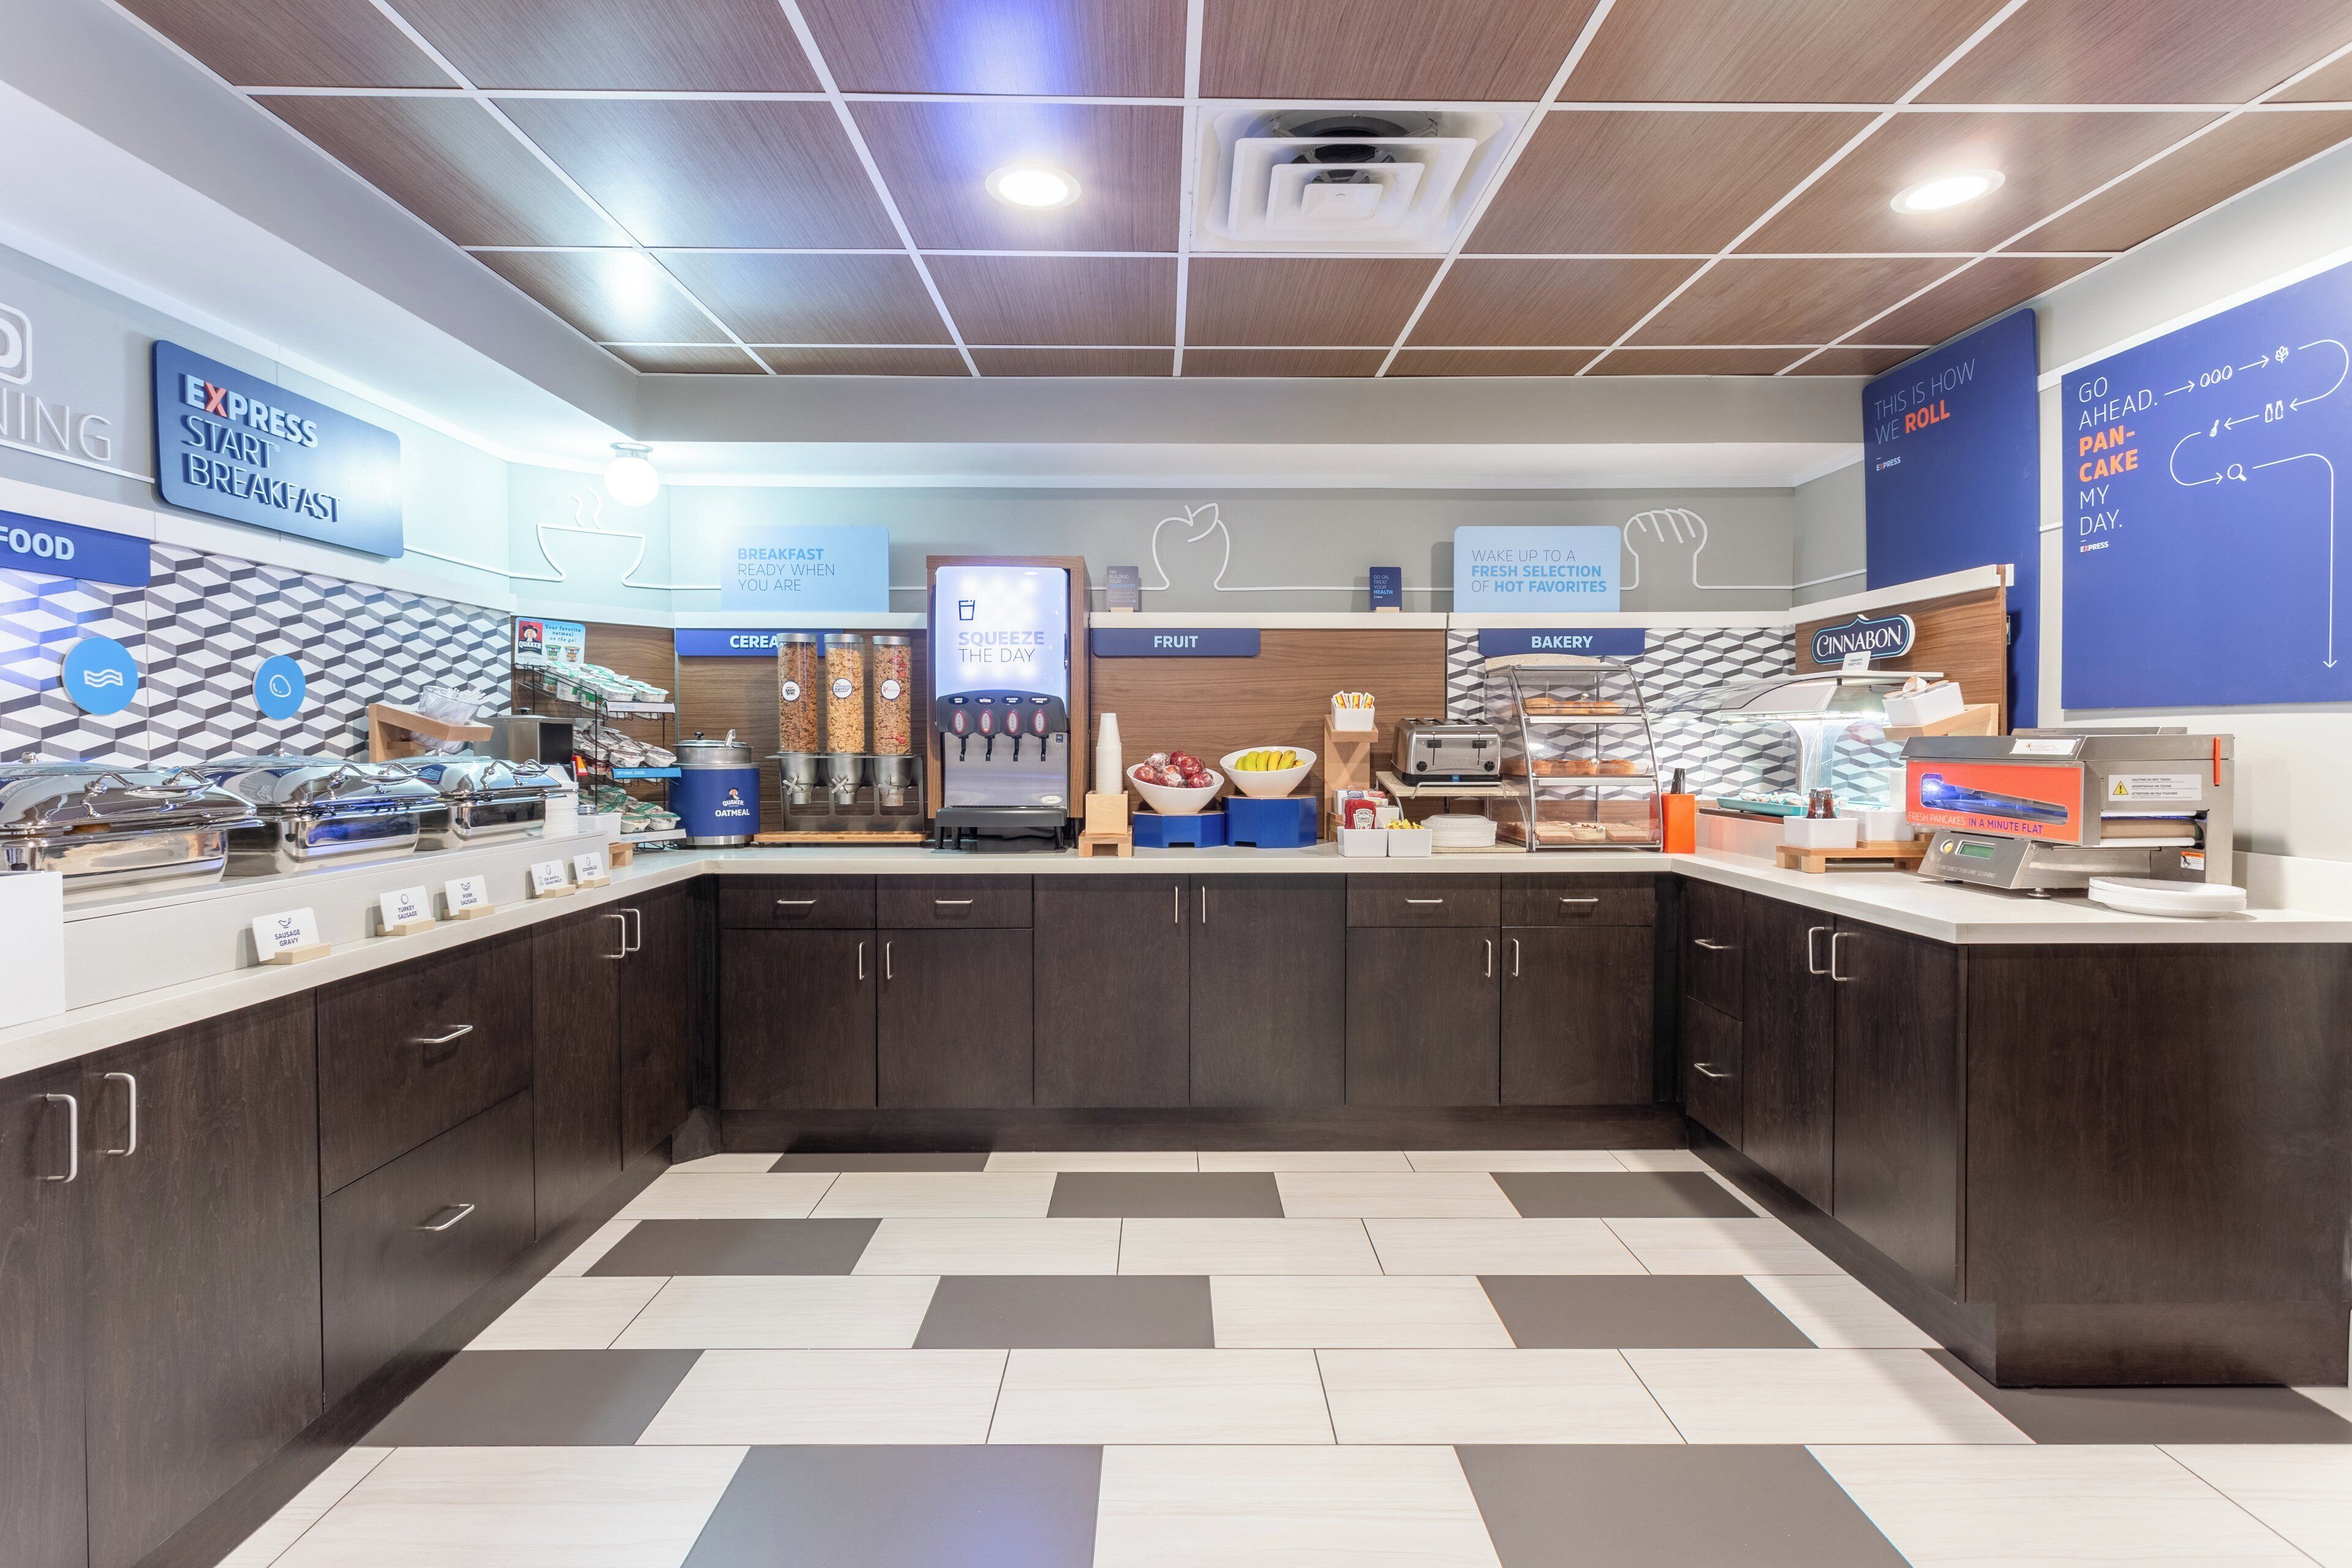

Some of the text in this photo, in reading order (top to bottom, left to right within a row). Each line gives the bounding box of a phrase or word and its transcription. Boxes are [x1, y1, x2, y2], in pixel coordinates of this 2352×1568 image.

[1874, 358, 1975, 420] THIS IS HOW
[2079, 377, 2108, 403] GO
[186, 374, 318, 448] EXPRESS
[2079, 389, 2158, 431] AHEAD.
[0, 387, 111, 461] ING
[1875, 399, 1950, 445] WE ROLL
[2079, 425, 2135, 457] PAN-
[1876, 456, 1901, 472] EXPRESS
[2079, 448, 2138, 483] CAKE
[188, 453, 343, 522] BREAKFAST
[2080, 484, 2109, 510] MY
[2080, 509, 2123, 536] DAY.
[737, 548, 824, 560] BREAKFAST
[2080, 541, 2109, 552] EXPRESS
[1471, 550, 1576, 562] WAKE UP TO A
[737, 564, 835, 576] READY WHEN
[1471, 565, 1601, 577] FRESH SELECTION
[737, 579, 801, 591] YOU ARE
[1471, 581, 1607, 592] OF HOT FAVORITES
[519, 641, 541, 649] QUAKER
[959, 631, 1044, 647] SQUEEZE
[1154, 636, 1198, 647] FRUIT
[1531, 636, 1593, 648] BAKERY
[1816, 625, 1901, 657] CINNABON
[958, 649, 1035, 662] THE DAY
[1909, 812, 1928, 821] FRESH
[1930, 815, 1966, 825] PANCAKES
[1969, 818, 1976, 826] IN
[1988, 820, 2019, 831] MINUTE
[2022, 823, 2043, 834] FLAT
[398, 911, 418, 919] SAUSAGE
[274, 929, 301, 940] SAUSAGE
[279, 937, 298, 946] GRAVY
